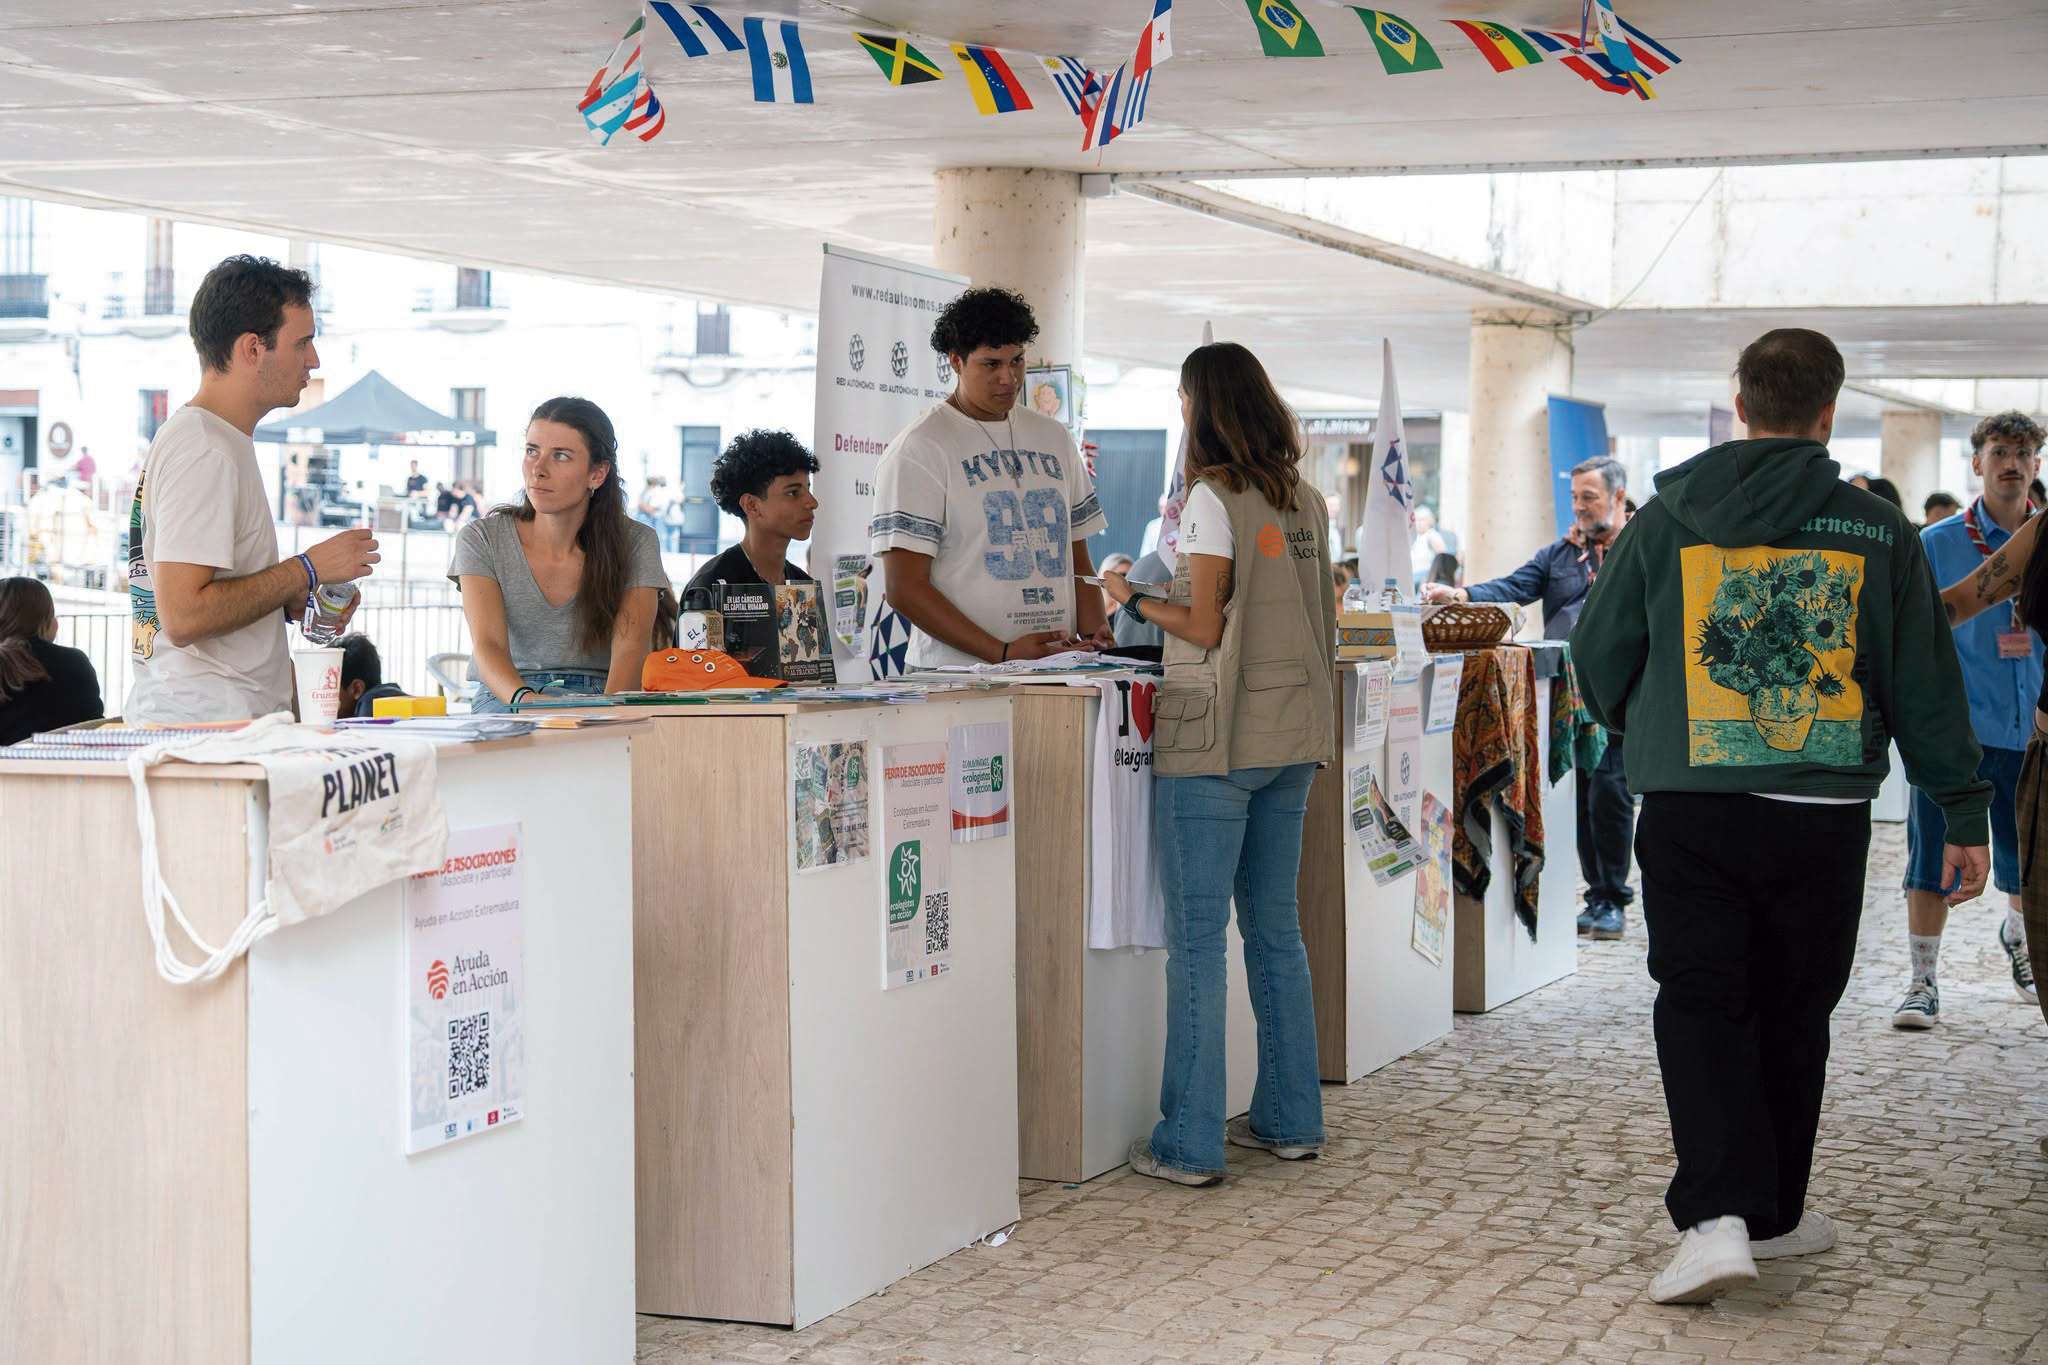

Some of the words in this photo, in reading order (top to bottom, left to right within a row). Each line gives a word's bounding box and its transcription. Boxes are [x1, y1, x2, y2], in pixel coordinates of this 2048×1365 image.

[835, 433, 888, 456] Defendemo
[962, 449, 1064, 487] KYOTO
[855, 480, 870, 496] tus
[1799, 517, 1894, 546] urnesols
[321, 752, 399, 818] PLANET
[452, 950, 491, 977] Ayuda
[452, 980, 469, 996] en
[469, 967, 509, 993] Acción
